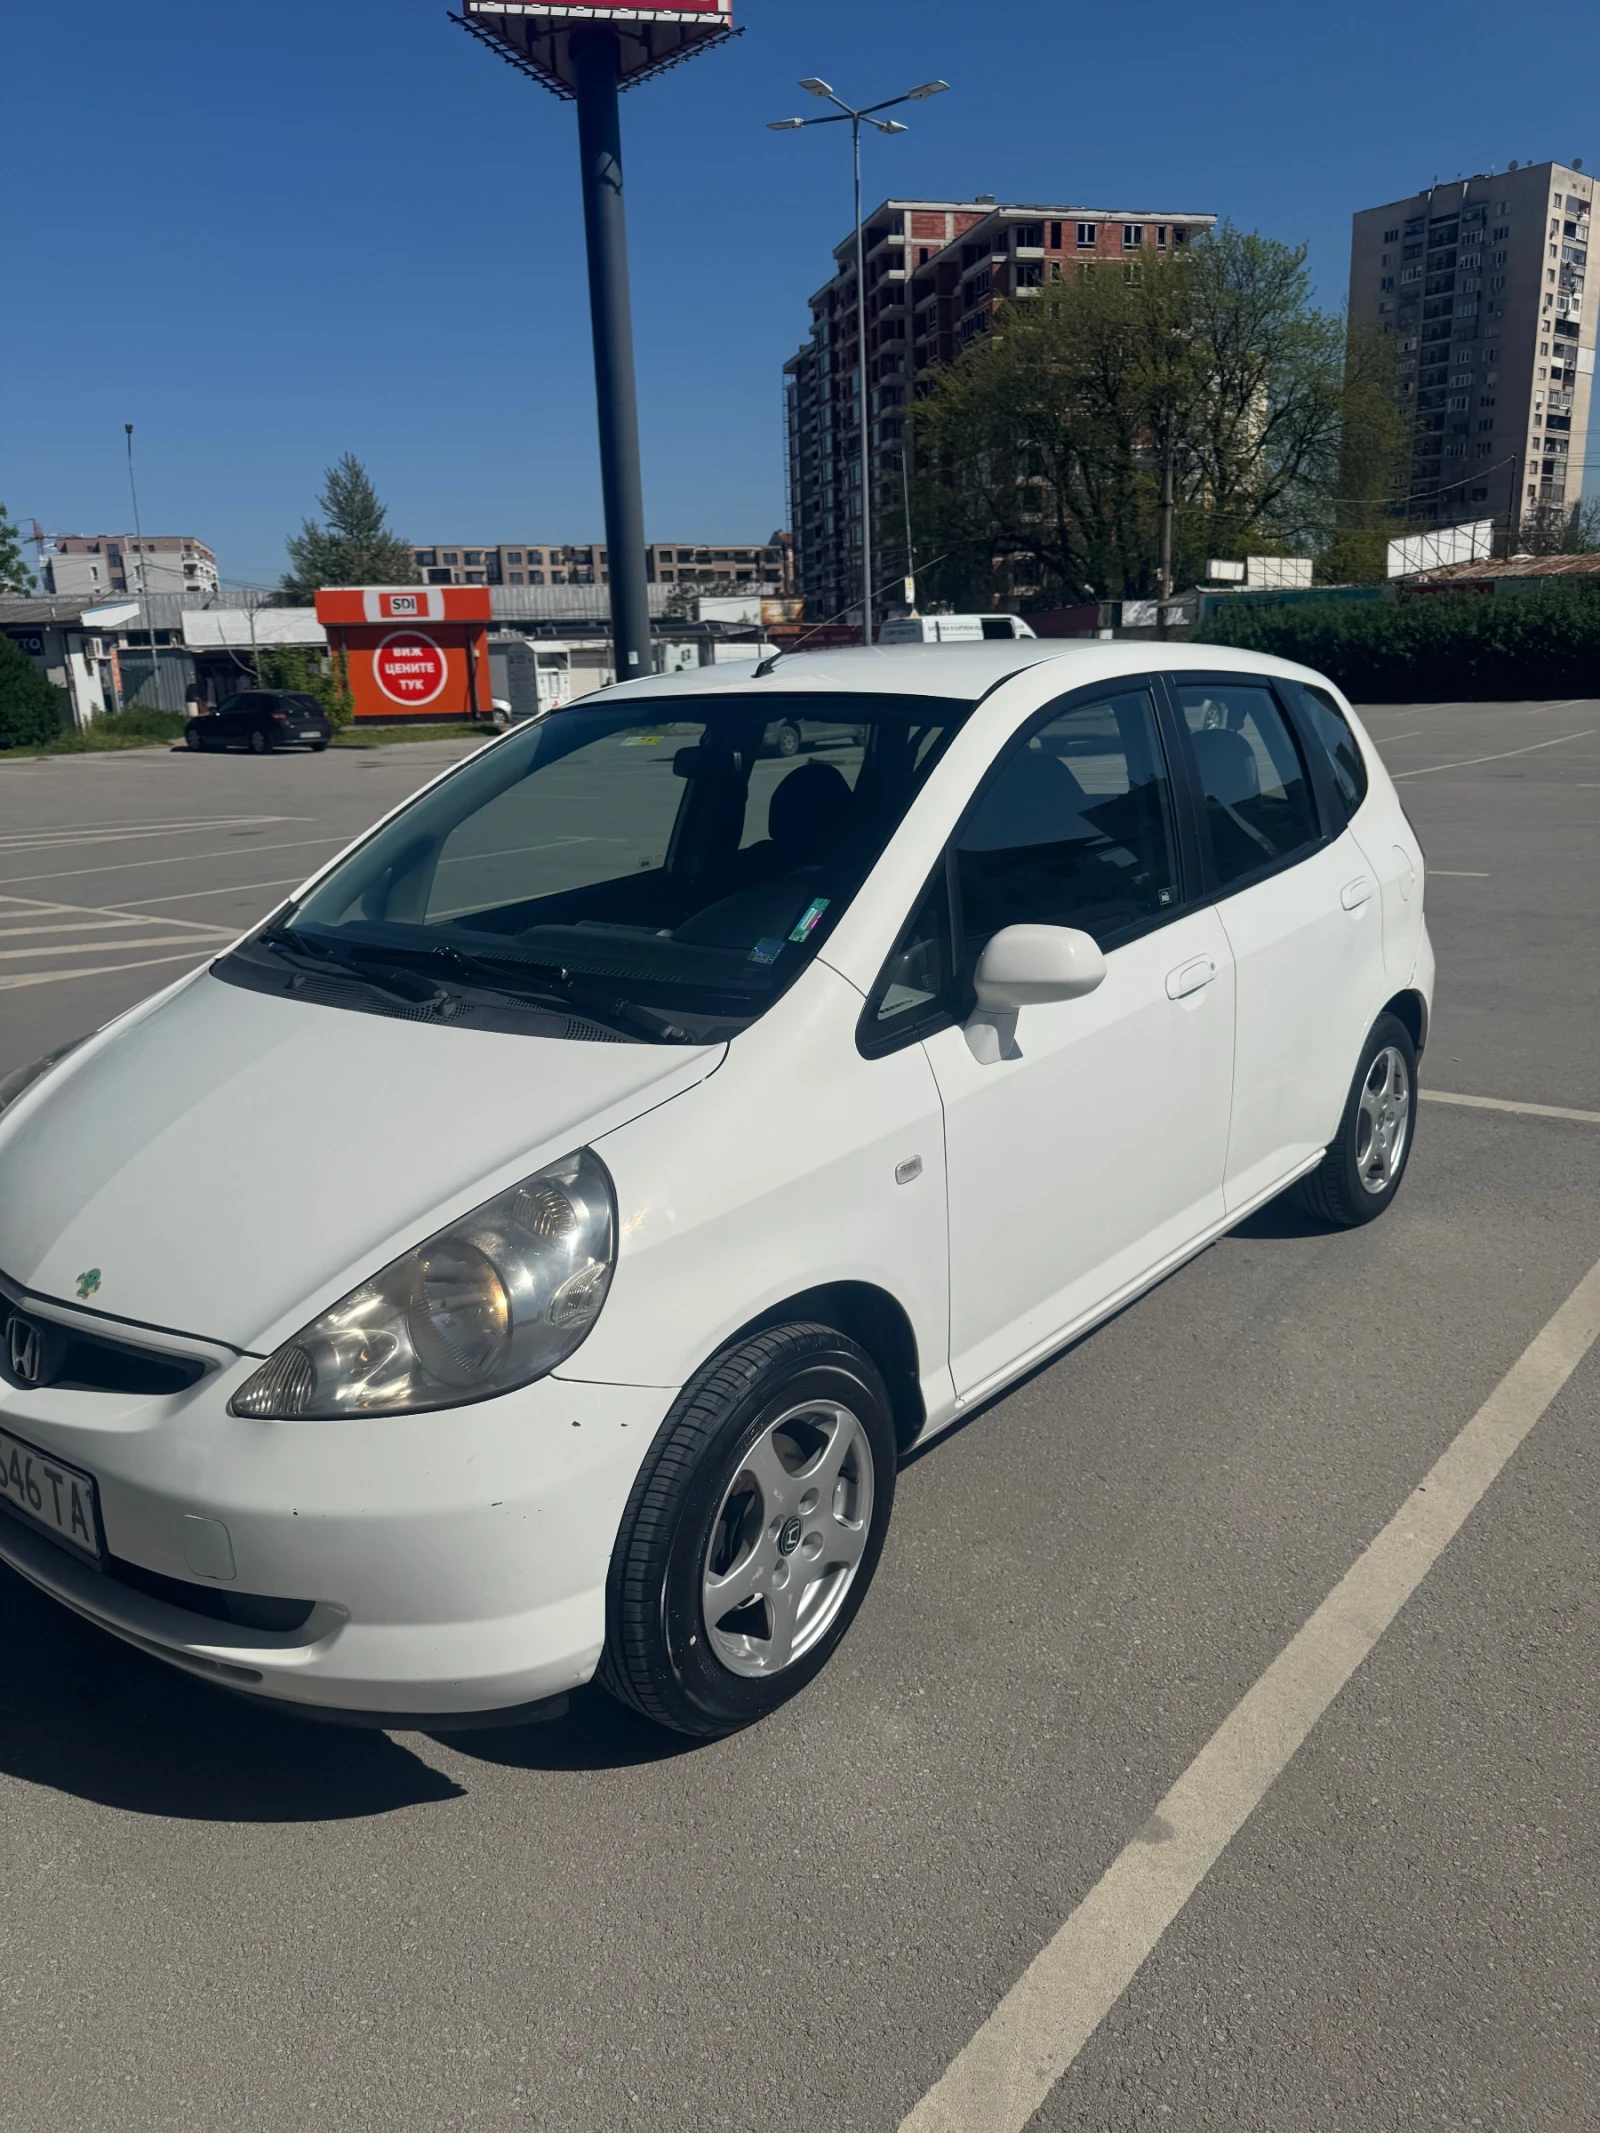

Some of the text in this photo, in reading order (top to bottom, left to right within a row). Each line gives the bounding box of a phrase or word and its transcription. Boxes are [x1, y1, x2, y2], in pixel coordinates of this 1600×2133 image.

[392, 598, 416, 610] SDI
[393, 647, 424, 657] ВИЖ
[384, 662, 436, 676] ЦЕНИТЕ
[398, 679, 425, 691] ТУК
